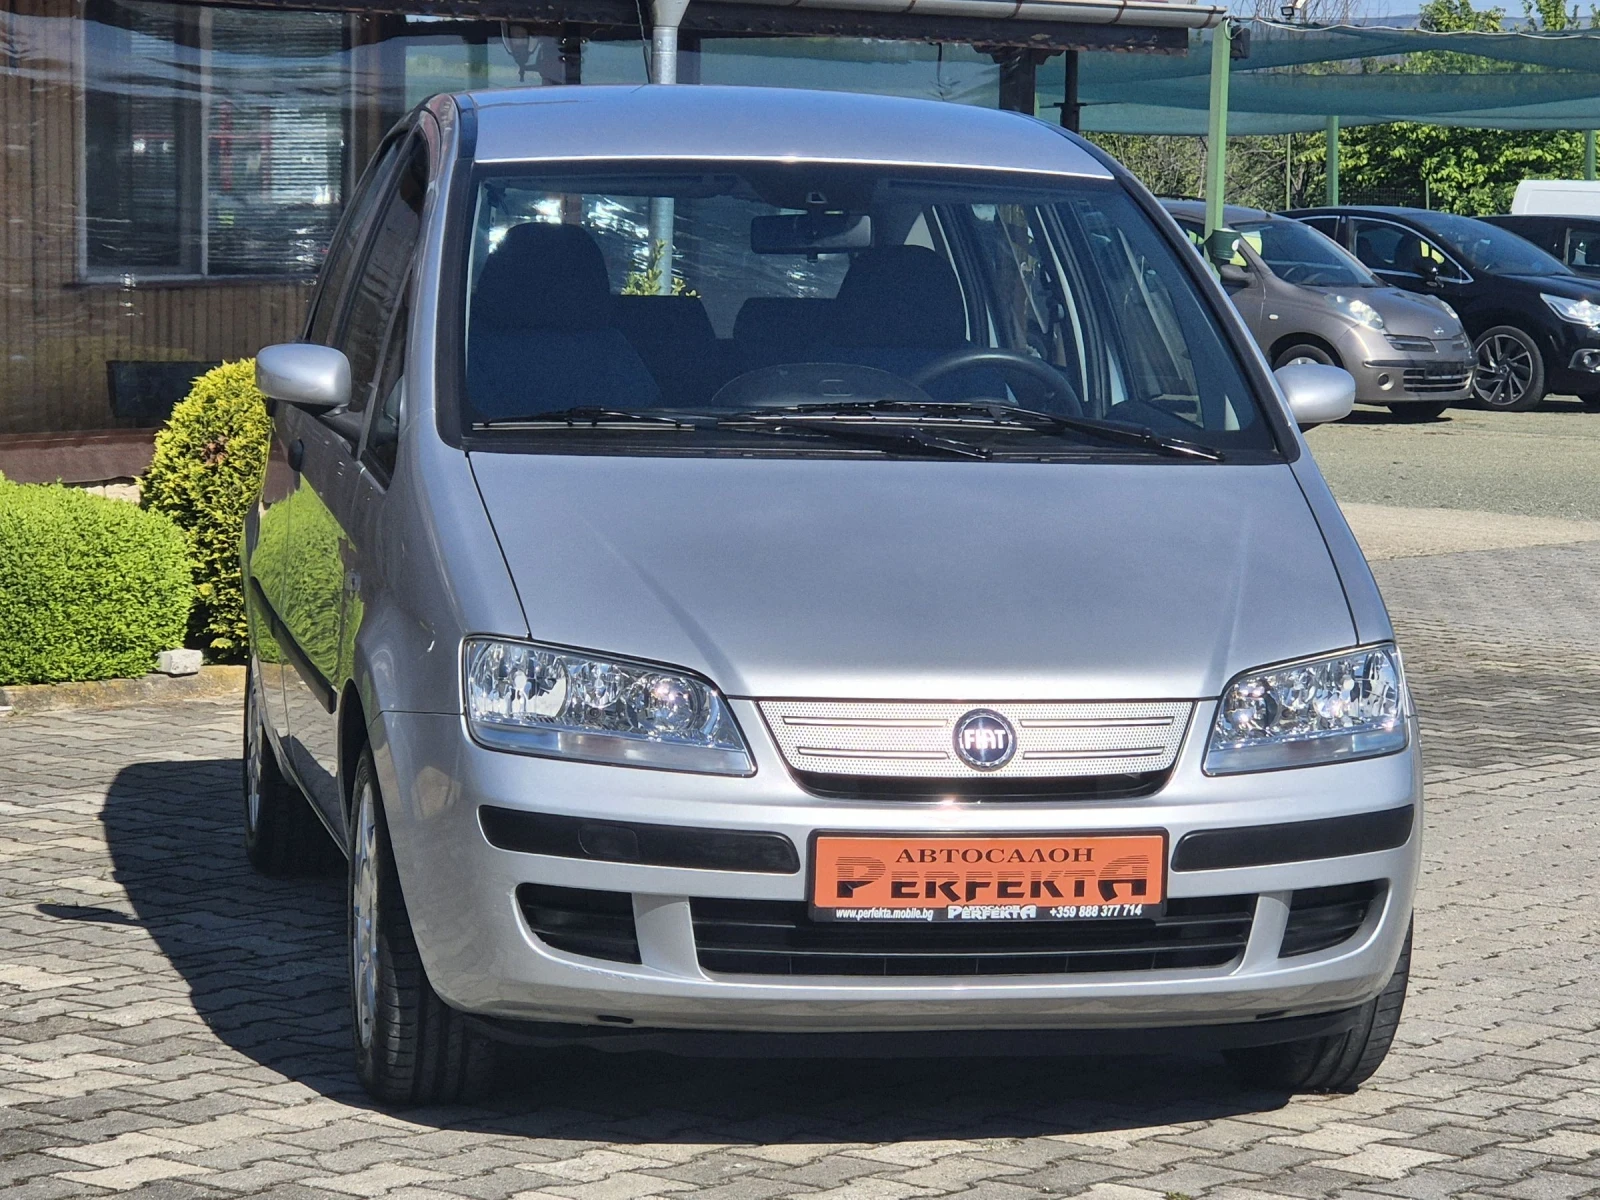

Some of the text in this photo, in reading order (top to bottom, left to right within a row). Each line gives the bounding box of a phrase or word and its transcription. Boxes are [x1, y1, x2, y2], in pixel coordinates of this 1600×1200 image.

[963, 729, 1006, 750] FIAT
[895, 847, 1094, 863] АВТОСАЛОН
[835, 854, 1149, 902] PERFEKTA
[835, 907, 934, 921] www.perfekta.mobile.bg
[1049, 904, 1143, 918] +359 888 377 714
